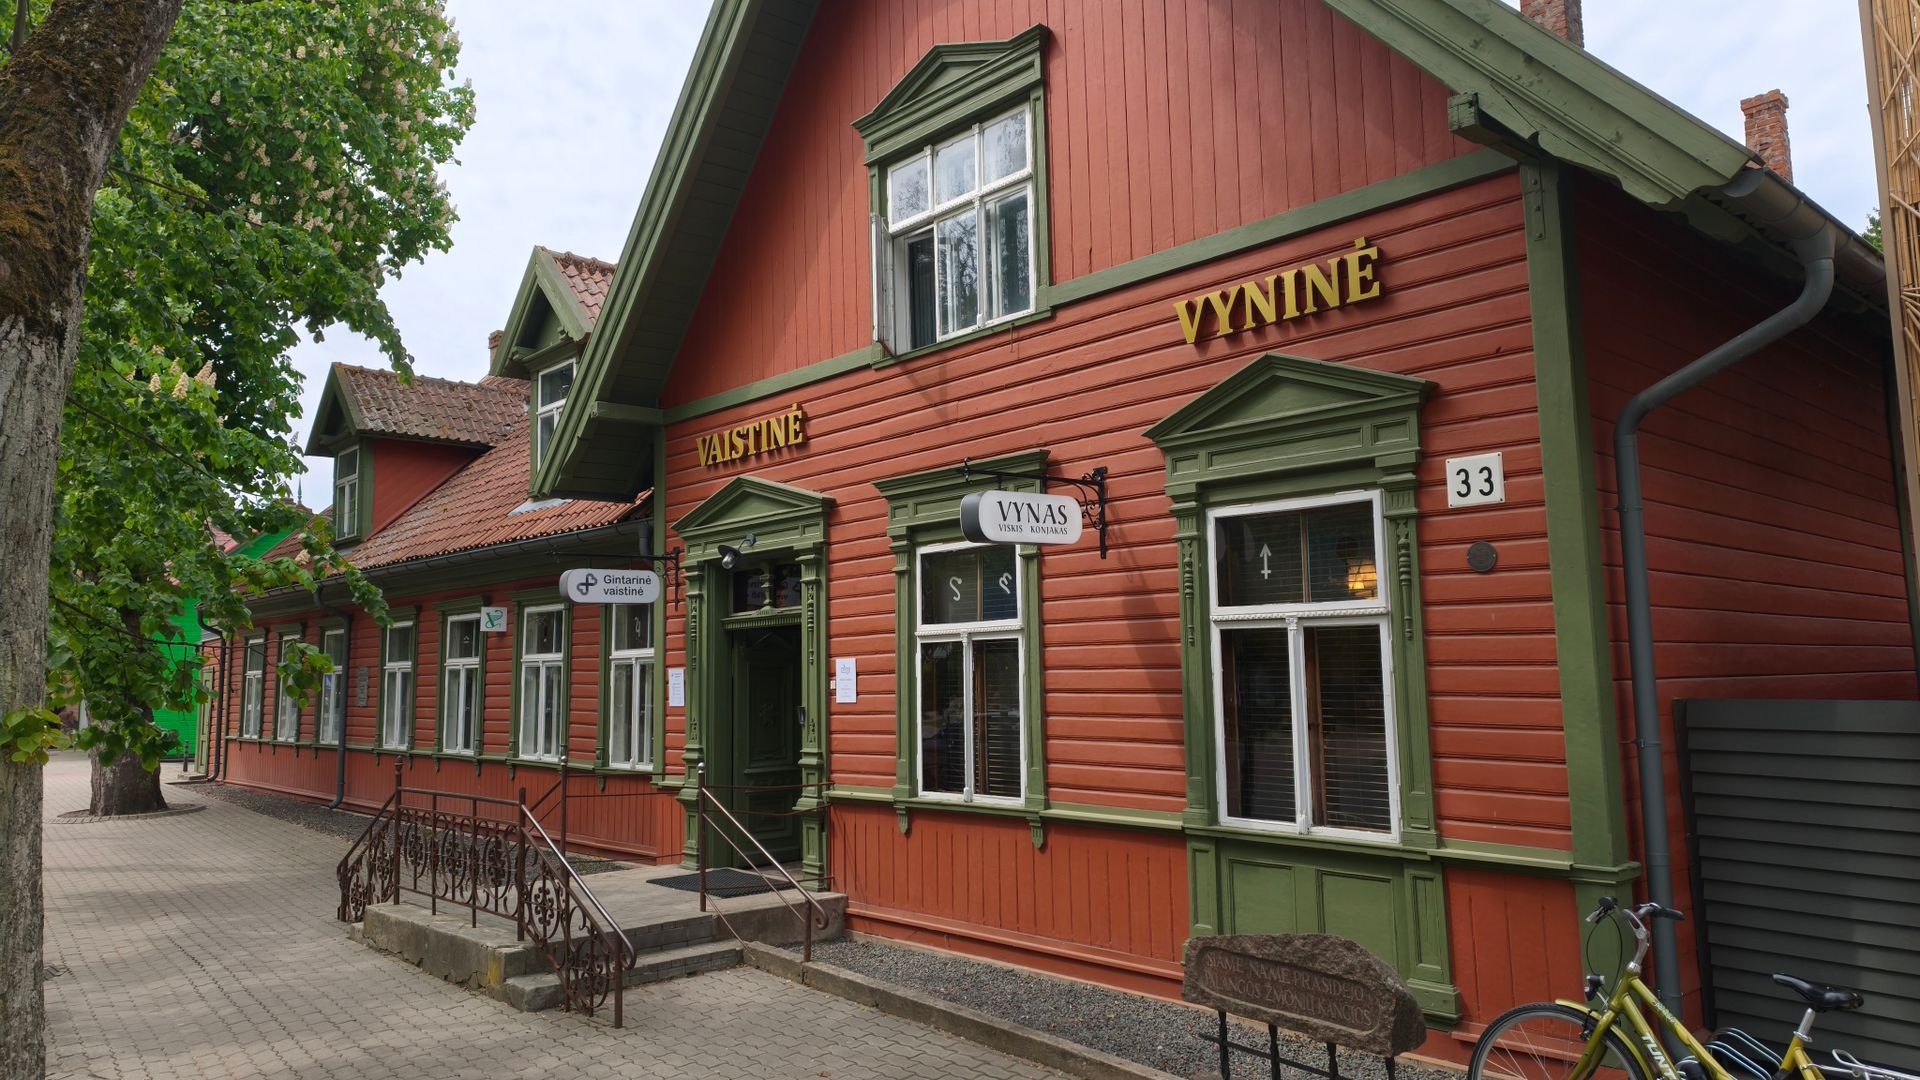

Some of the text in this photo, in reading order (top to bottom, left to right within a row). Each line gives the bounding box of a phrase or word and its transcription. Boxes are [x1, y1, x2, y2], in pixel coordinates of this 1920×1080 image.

[1173, 236, 1380, 344] VYNINĖ
[696, 402, 803, 468] VAISTINĖ
[1456, 466, 1494, 498] 33
[996, 500, 1068, 526] VYNAS
[998, 523, 1068, 535] VISKIS KONJAKAS
[603, 574, 652, 585] Gintarinė
[603, 586, 644, 596] vaistinė
